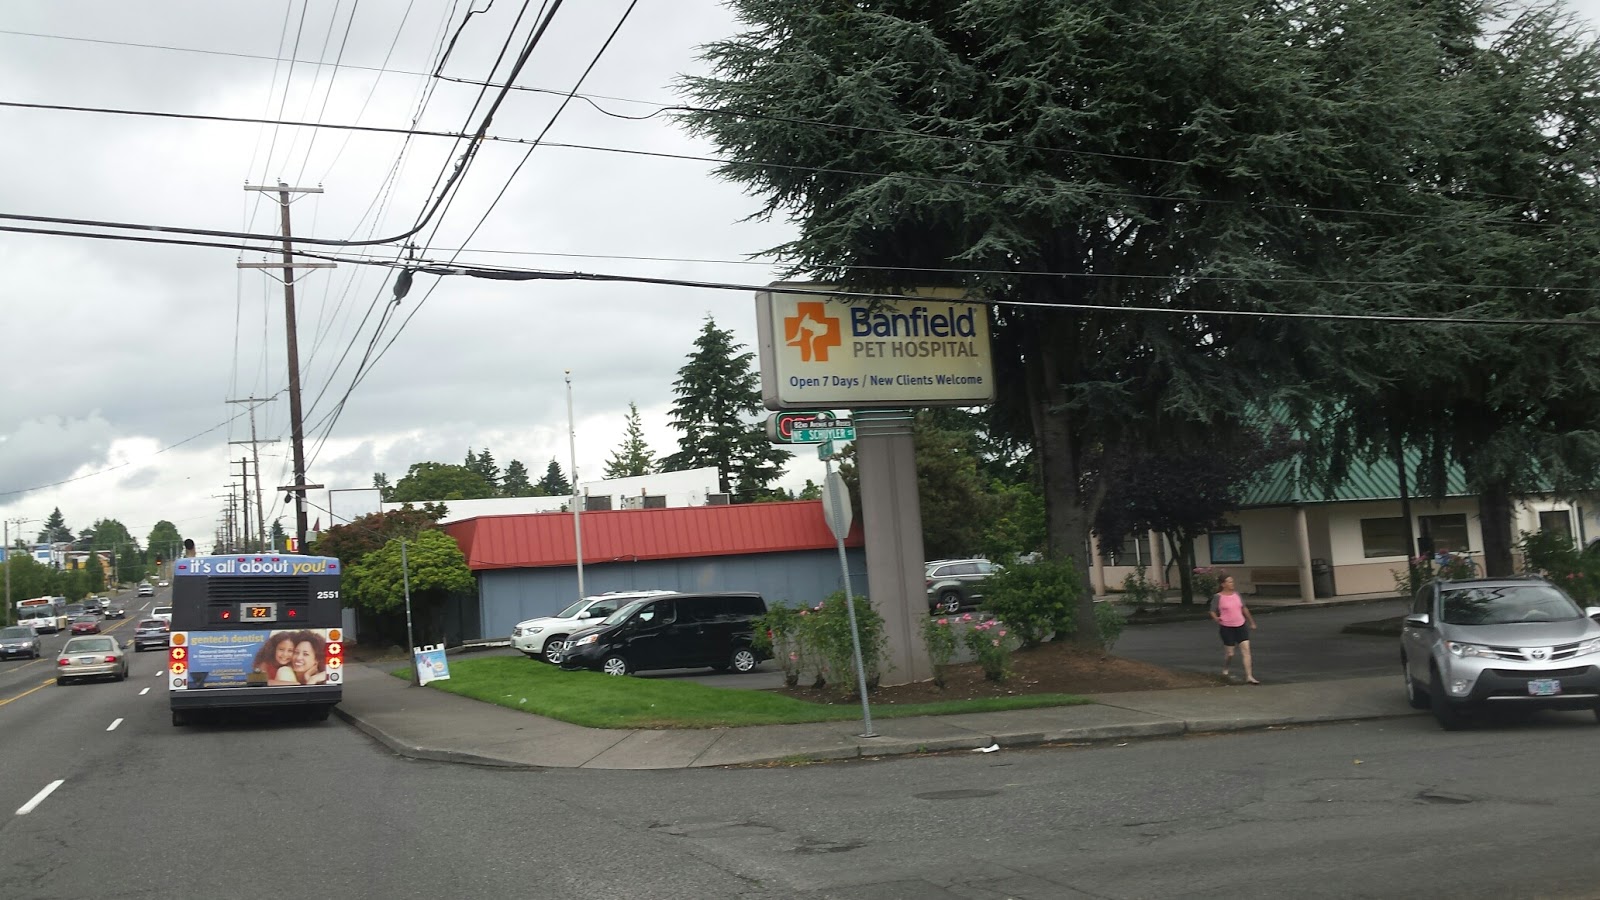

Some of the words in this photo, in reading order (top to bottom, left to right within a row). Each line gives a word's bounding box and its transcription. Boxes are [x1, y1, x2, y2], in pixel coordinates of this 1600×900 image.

[850, 306, 977, 338] Banfield
[853, 341, 886, 358] PET
[892, 340, 979, 357] HOSPITAL
[789, 376, 820, 389] Open
[822, 376, 829, 387] 7
[832, 375, 859, 389] Days
[870, 375, 893, 386] New
[896, 374, 933, 386] Clients
[936, 373, 983, 385] Welcome
[793, 430, 803, 440] NE
[808, 429, 846, 440] SCHUYLER
[190, 559, 211, 574] it's
[215, 559, 235, 574] all
[239, 559, 289, 574] about
[292, 559, 326, 576] you!
[316, 591, 339, 600] 2551
[191, 634, 229, 646] gentech
[231, 633, 265, 643] dentist
